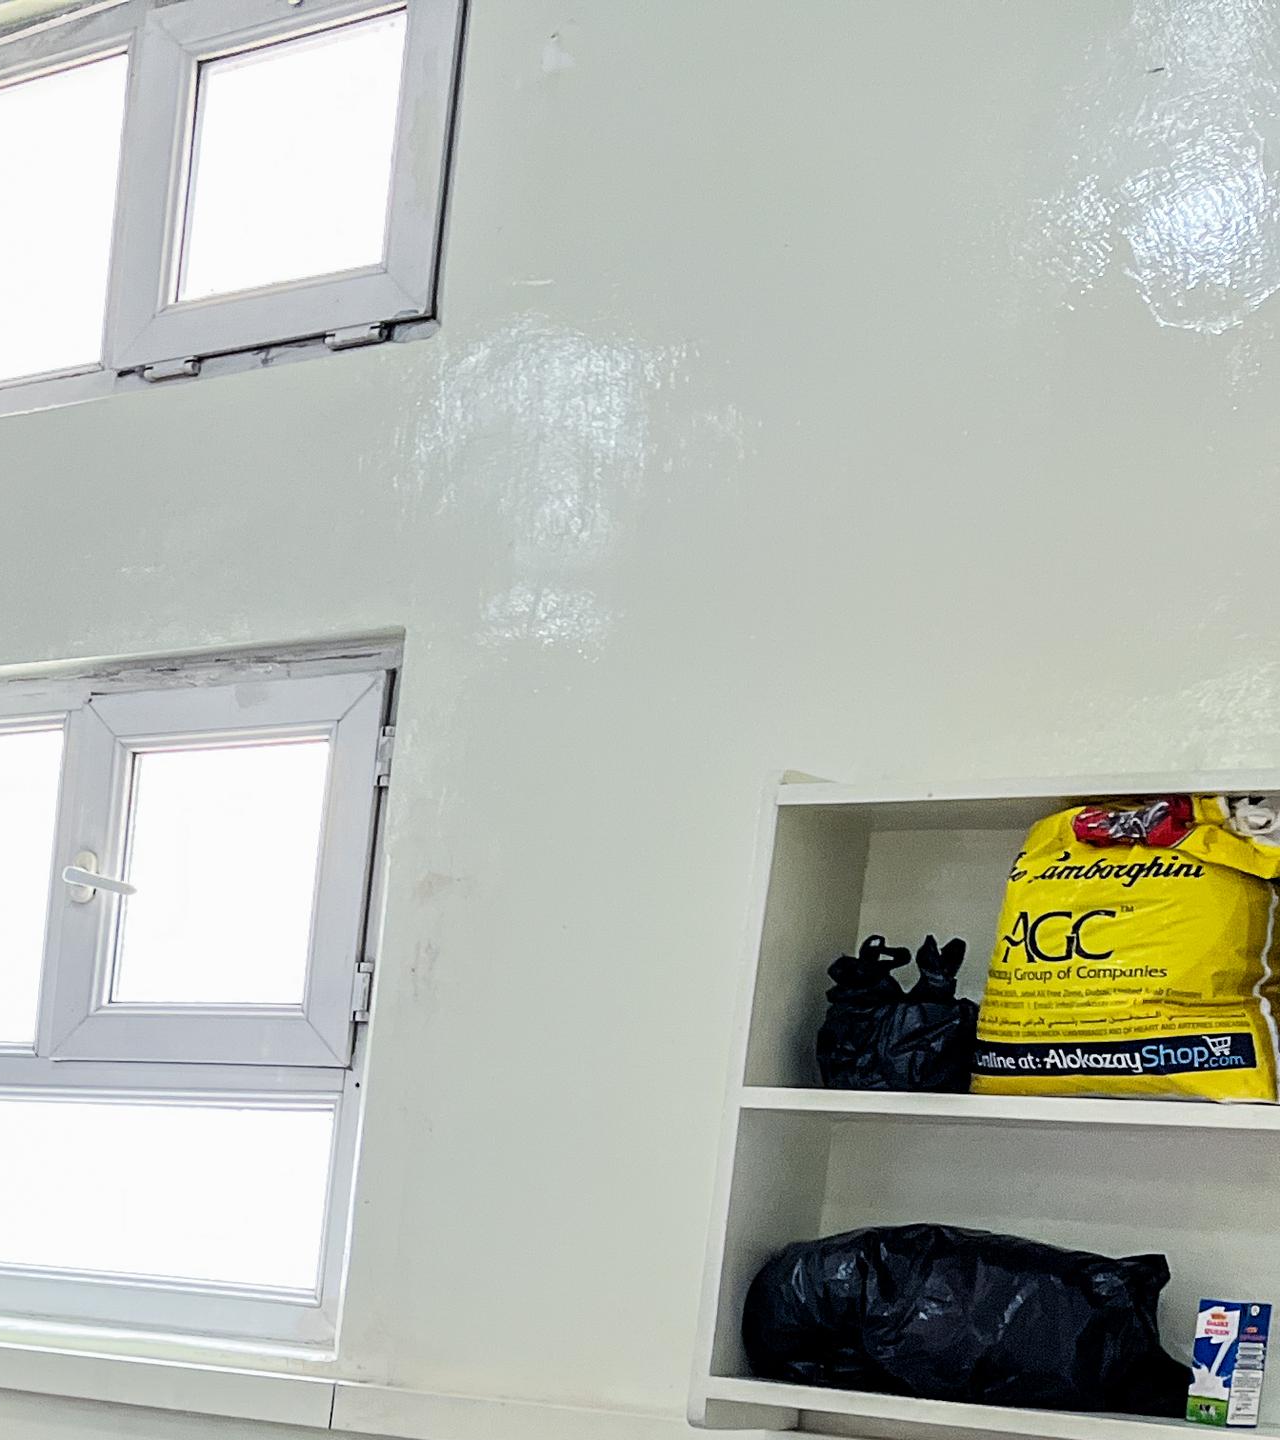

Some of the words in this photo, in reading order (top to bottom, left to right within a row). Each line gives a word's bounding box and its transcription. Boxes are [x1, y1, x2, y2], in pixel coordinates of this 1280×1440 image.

[1002, 909, 1117, 964] AGC
[1014, 968, 1053, 983] Group
[1056, 966, 1073, 979] of
[1076, 965, 1167, 981] Companies
[1018, 1053, 1042, 1069] at:
